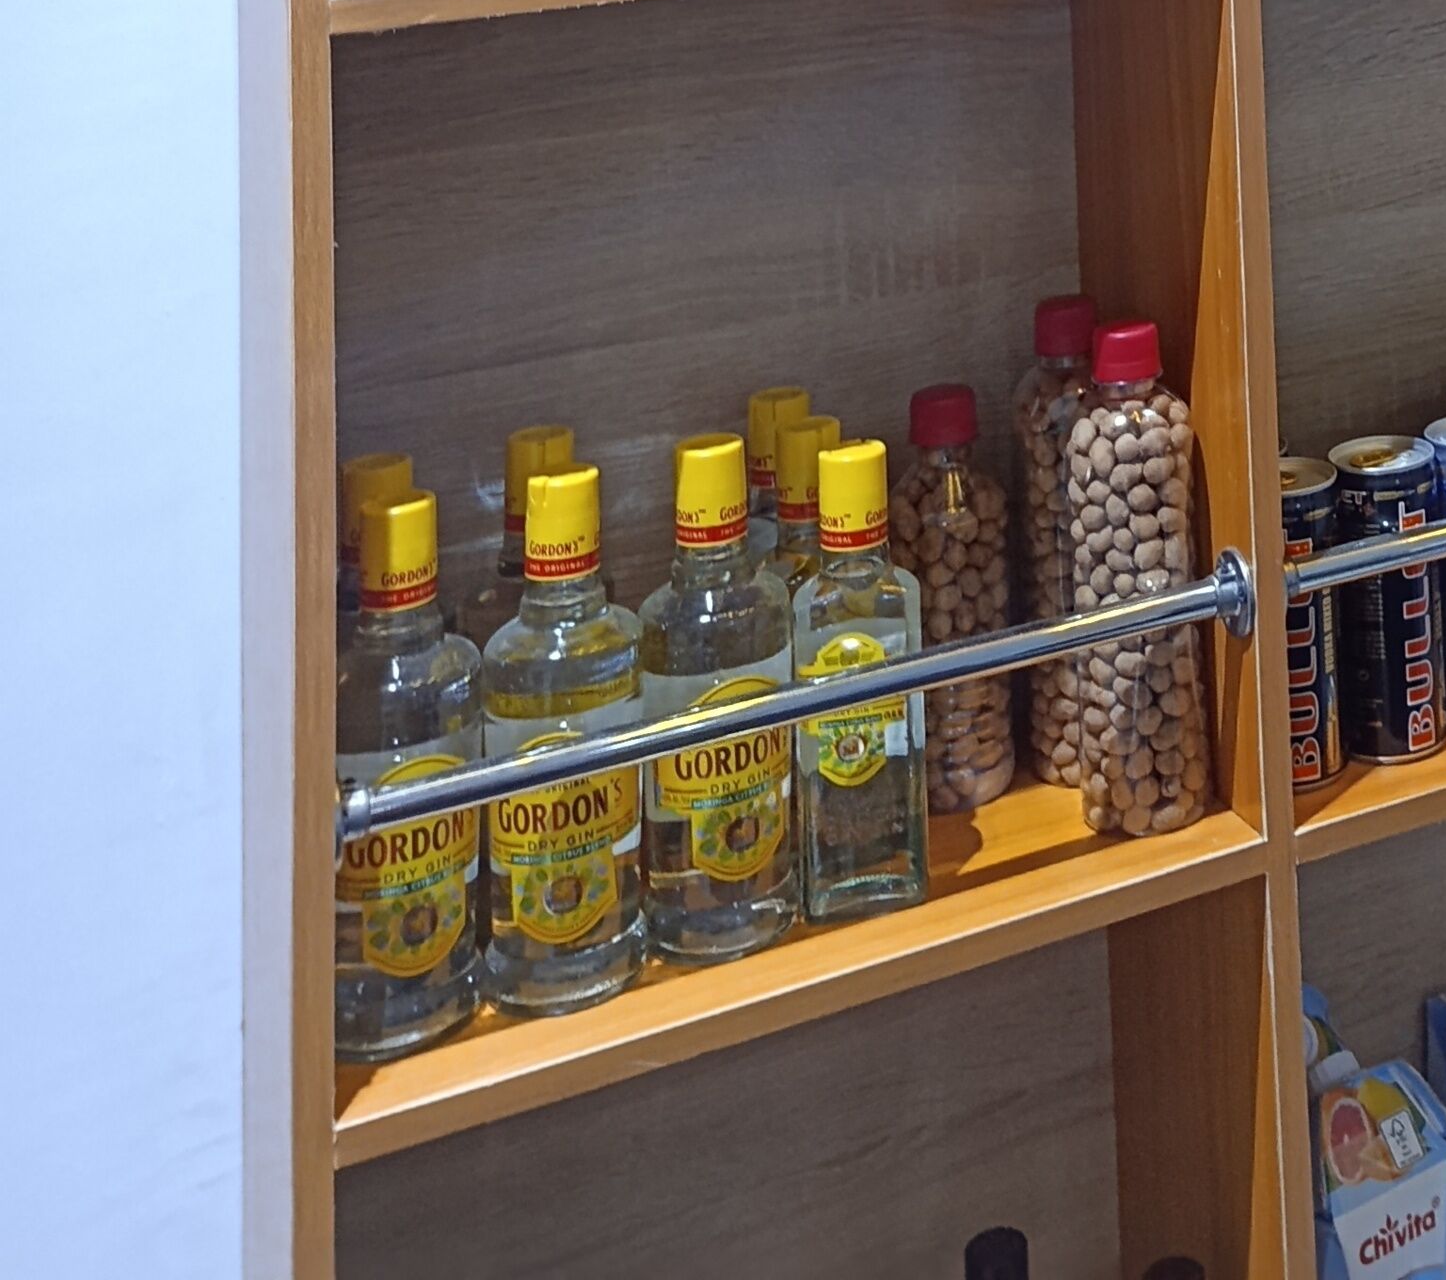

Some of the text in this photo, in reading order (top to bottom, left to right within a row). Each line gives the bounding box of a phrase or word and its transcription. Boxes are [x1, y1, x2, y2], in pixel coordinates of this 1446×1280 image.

[544, 559, 586, 573] ORIGINAL
[710, 767, 772, 795] DRY GIN
[498, 777, 624, 836] GORDON'S
[692, 794, 735, 810] MORINGA
[527, 828, 596, 852] DRY GIN
[383, 853, 452, 885] DRY GIN
[1358, 1207, 1437, 1266] Chivita
